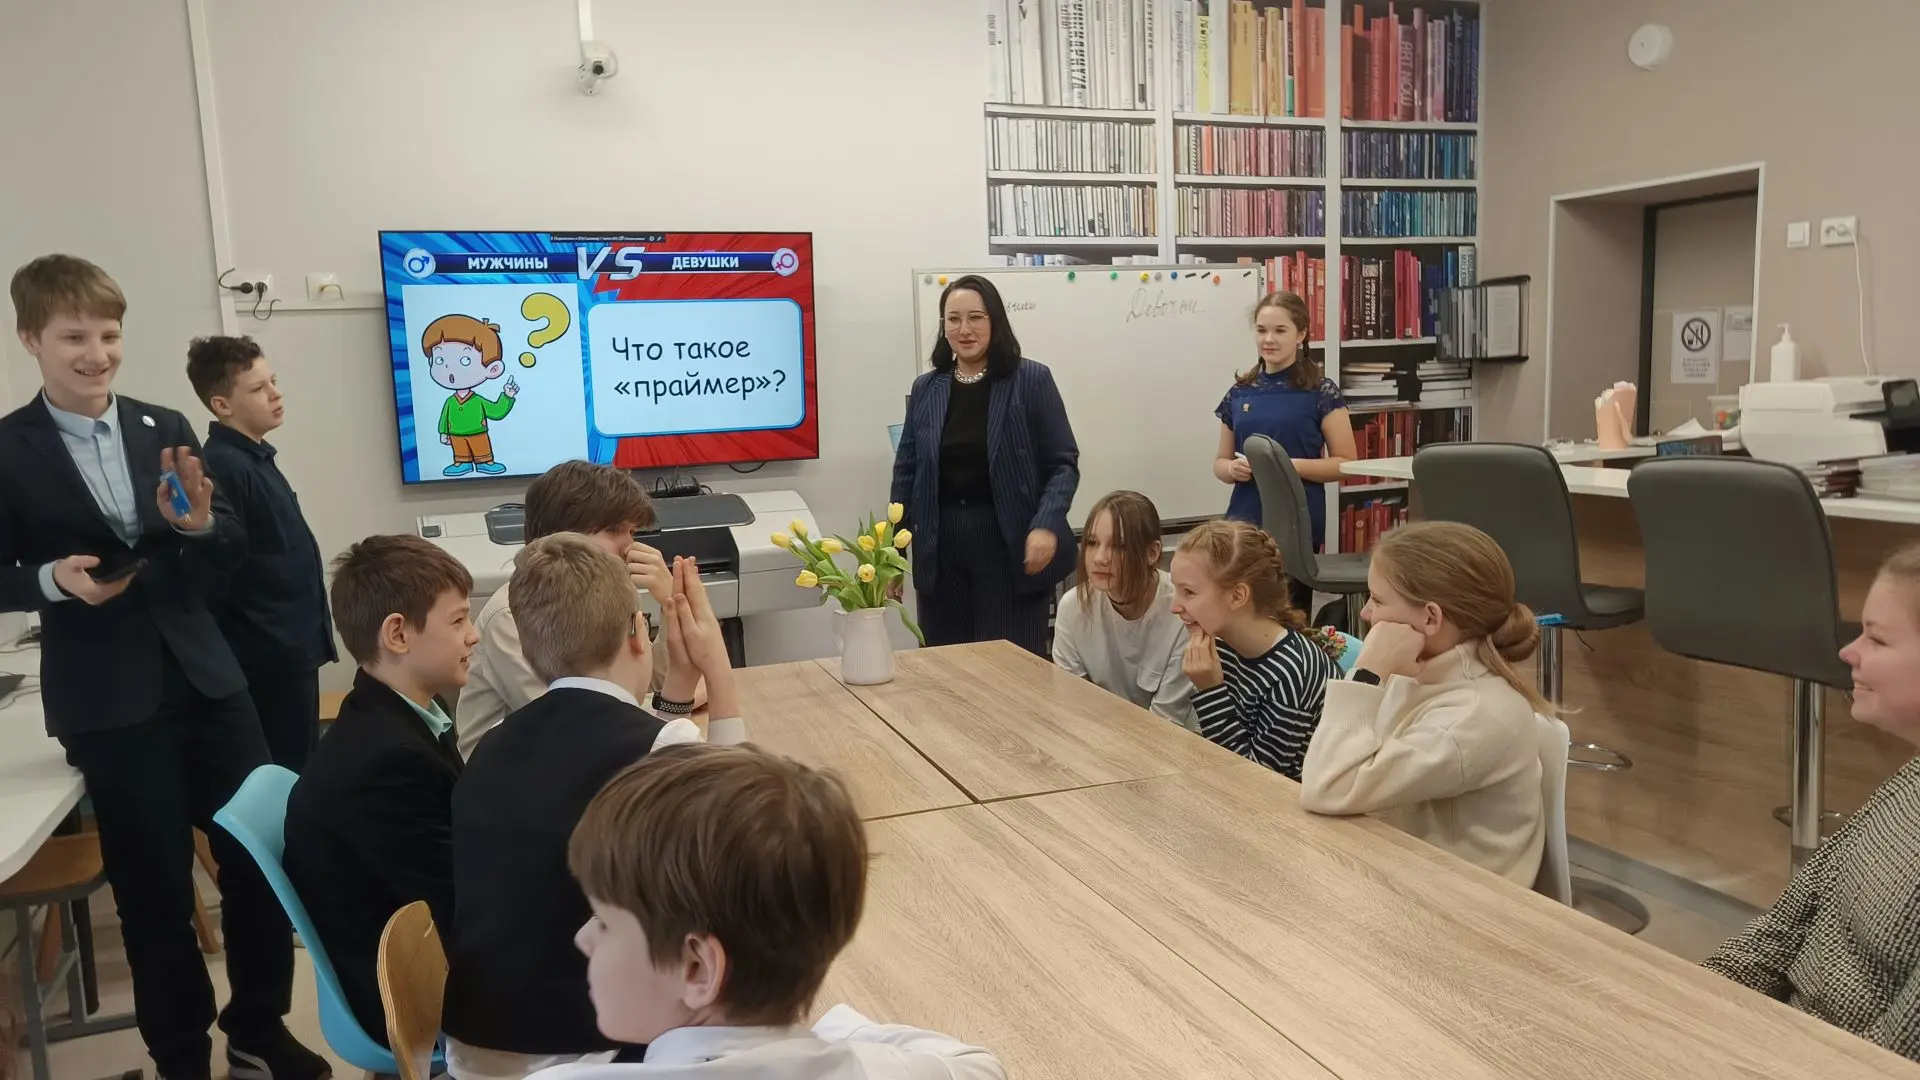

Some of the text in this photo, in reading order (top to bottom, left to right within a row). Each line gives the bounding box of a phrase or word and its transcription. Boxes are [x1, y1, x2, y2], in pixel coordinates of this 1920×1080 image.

[1400, 41, 1414, 107] ART NOW
[468, 255, 548, 271] МУЖЧИНЫ
[576, 245, 646, 281] VS
[672, 255, 740, 270] ДЕВУШКИ
[612, 336, 751, 361] Что такое
[614, 369, 787, 404] «праймер»?
